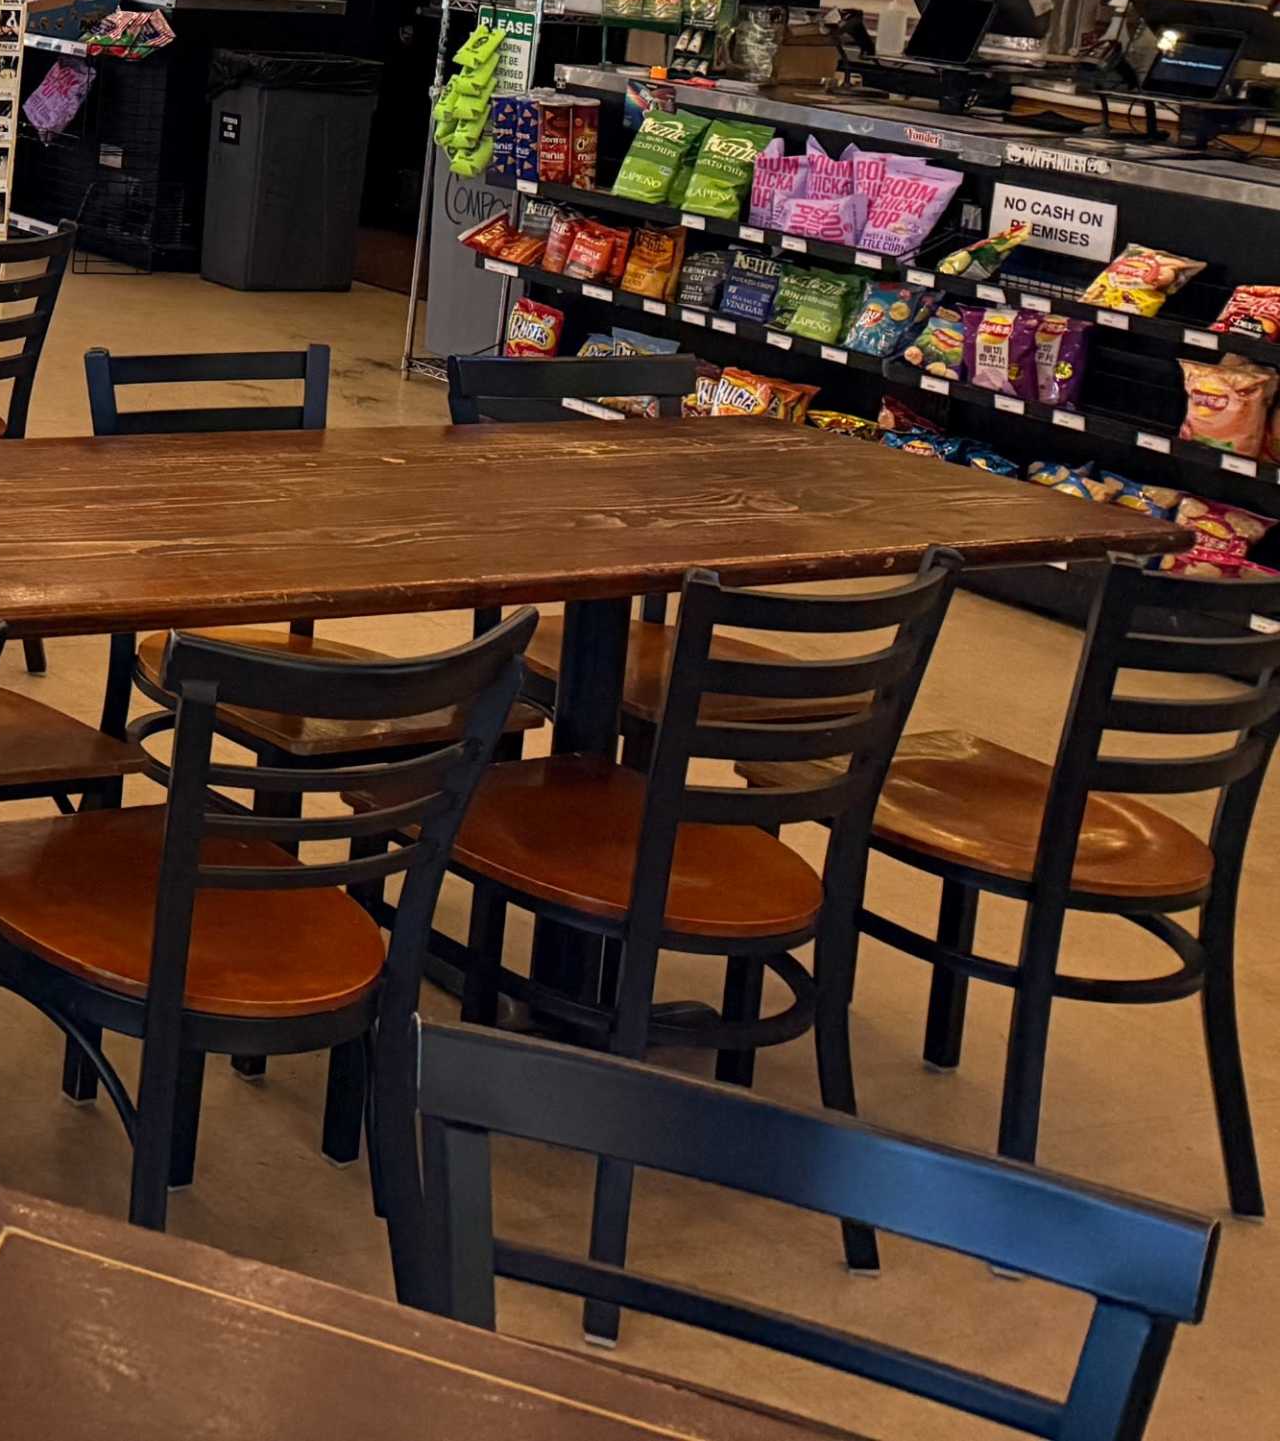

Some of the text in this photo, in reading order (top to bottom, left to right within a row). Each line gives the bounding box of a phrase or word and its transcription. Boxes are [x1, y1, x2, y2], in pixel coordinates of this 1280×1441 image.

[541, 152, 565, 161] minis
[754, 169, 795, 192] HICKA
[811, 174, 853, 197] HICKA
[883, 176, 939, 204] BOOM
[751, 186, 773, 209] OP
[871, 195, 928, 220] CHICKA
[866, 209, 900, 229] POP
[1003, 195, 1104, 228] NO CASH ON
[1009, 218, 1090, 248] PEMISES
[734, 251, 782, 276] KETTLE
[725, 298, 764, 316] VINEGAR
